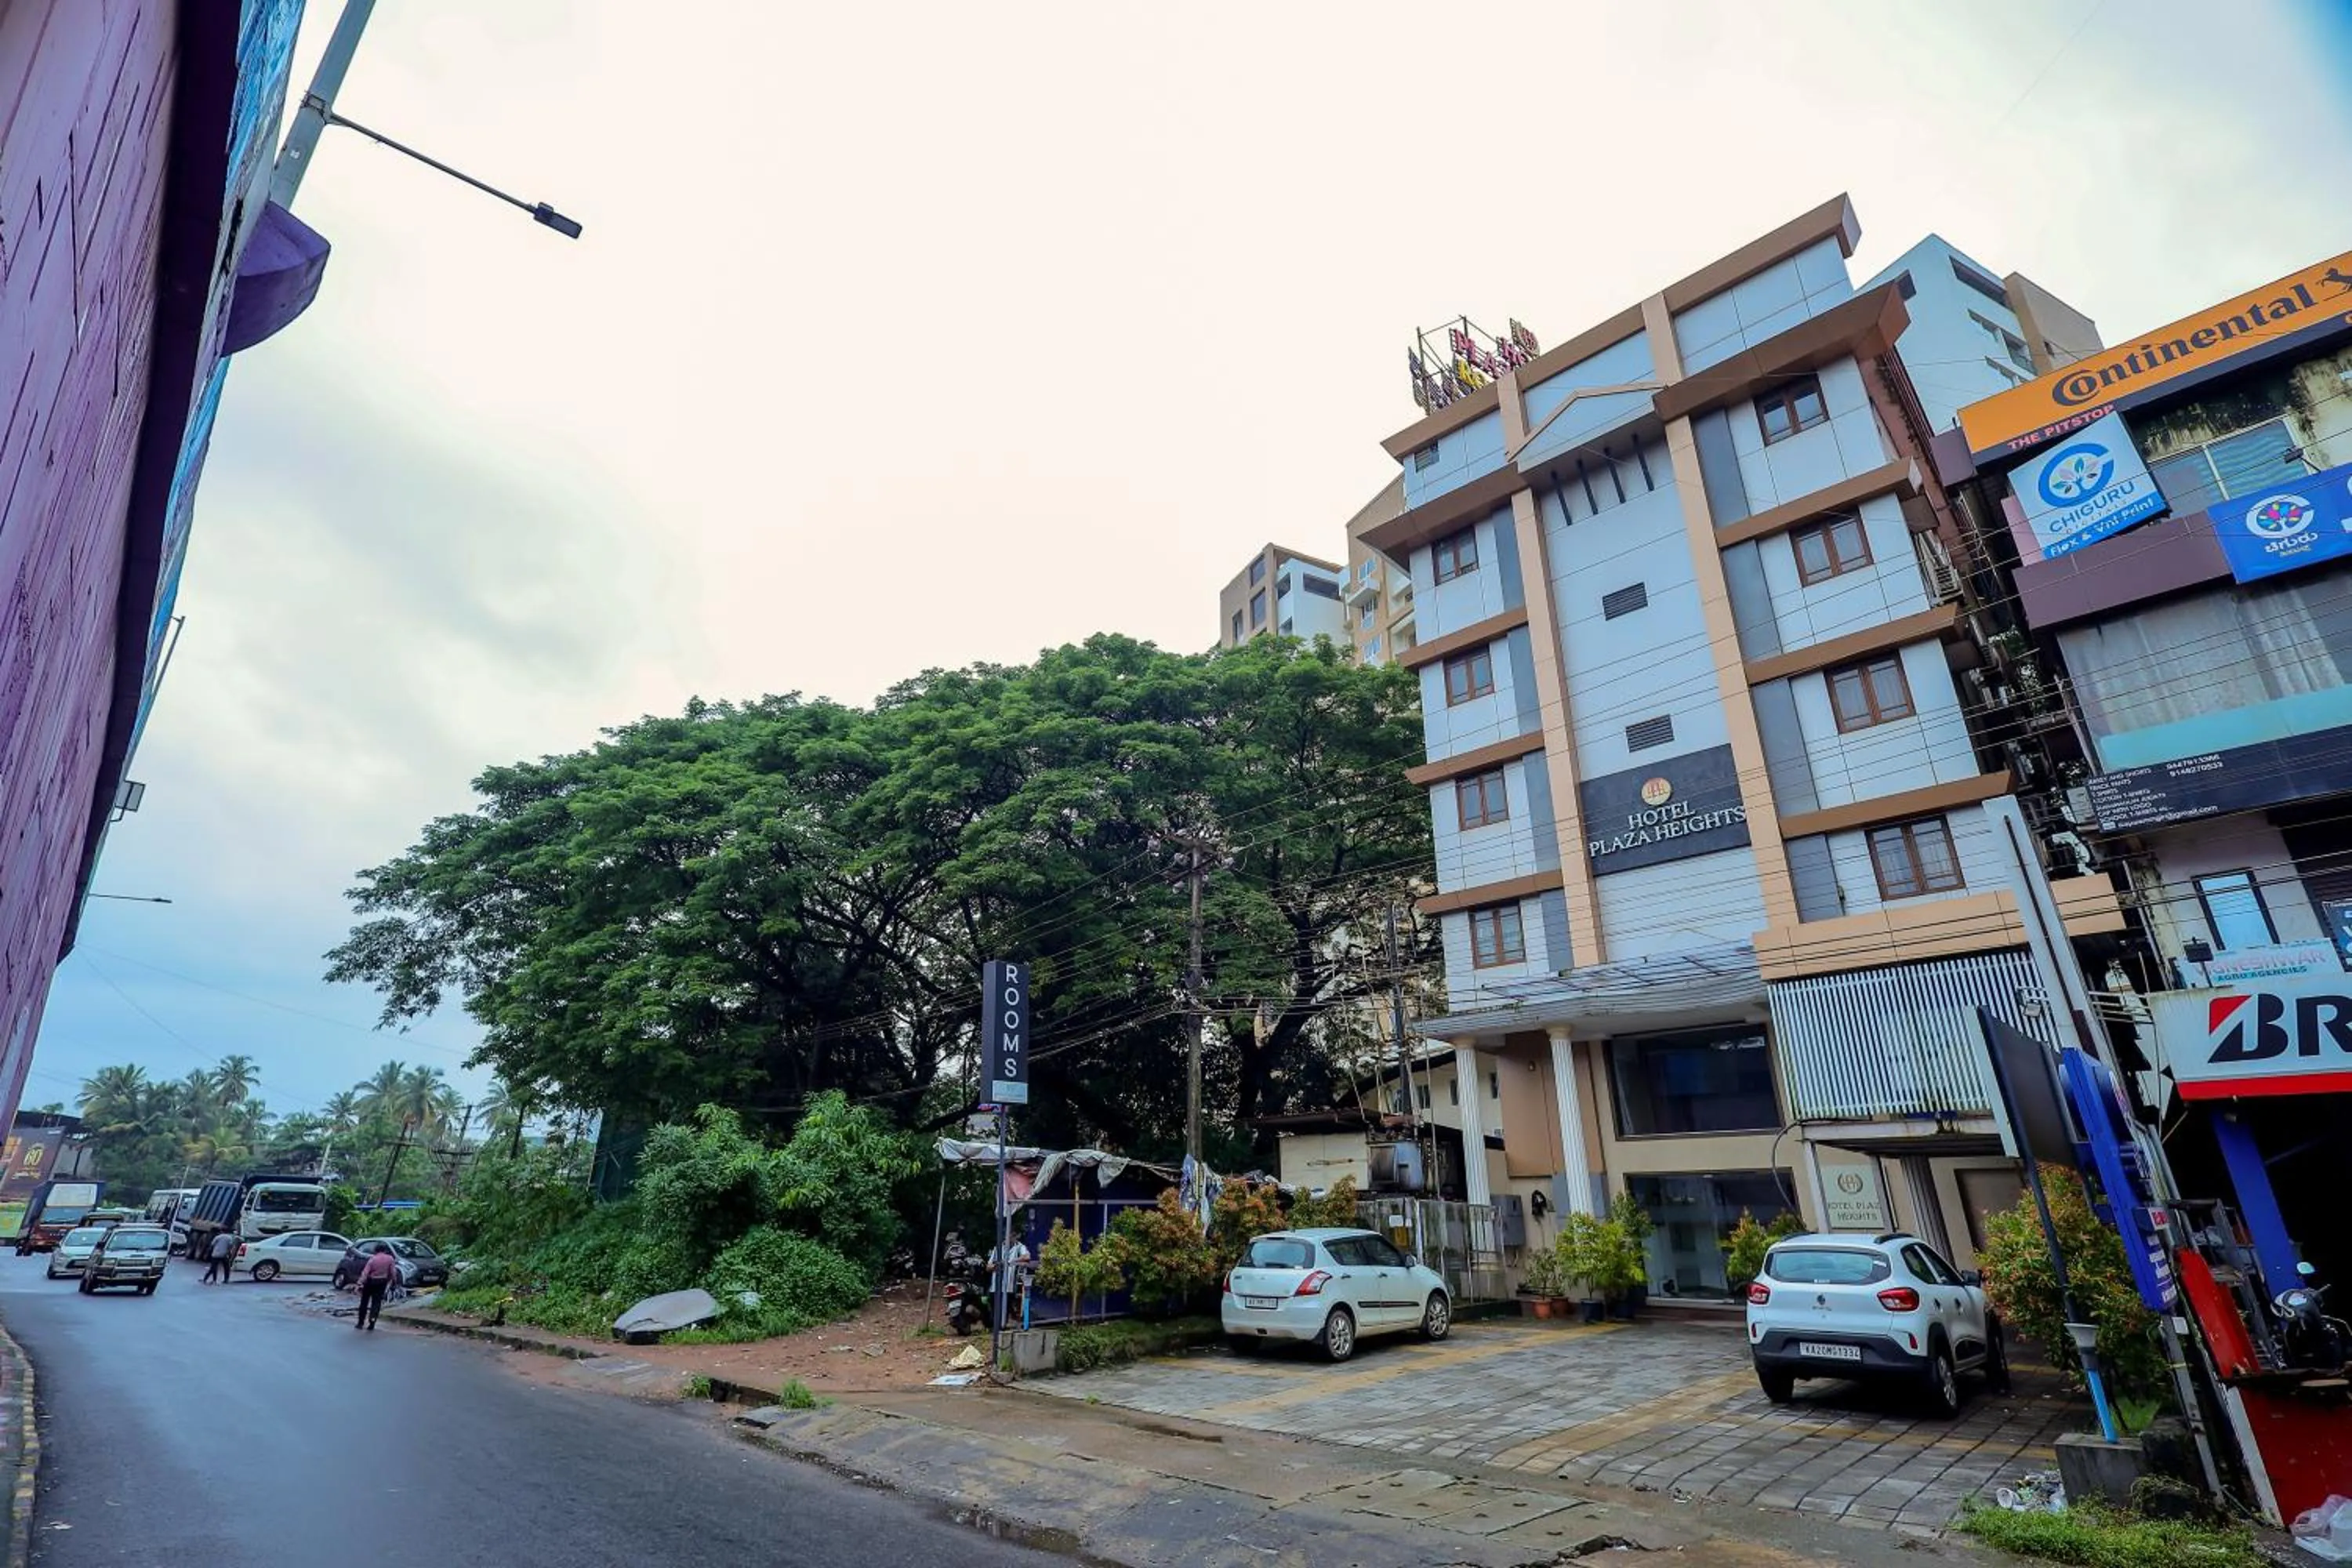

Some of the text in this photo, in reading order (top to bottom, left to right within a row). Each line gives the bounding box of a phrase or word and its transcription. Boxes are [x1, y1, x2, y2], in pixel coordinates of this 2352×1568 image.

[2052, 282, 2318, 406] Continental
[2008, 405, 2114, 451] THE PITSTOP
[2049, 481, 2135, 532] CHIGURU
[1588, 805, 1748, 858] PLAZA HEIGHTS
[1628, 800, 1697, 830] HOTEL
[2250, 964, 2307, 979] AGENCIES
[1003, 964, 1020, 1078] ROOMS
